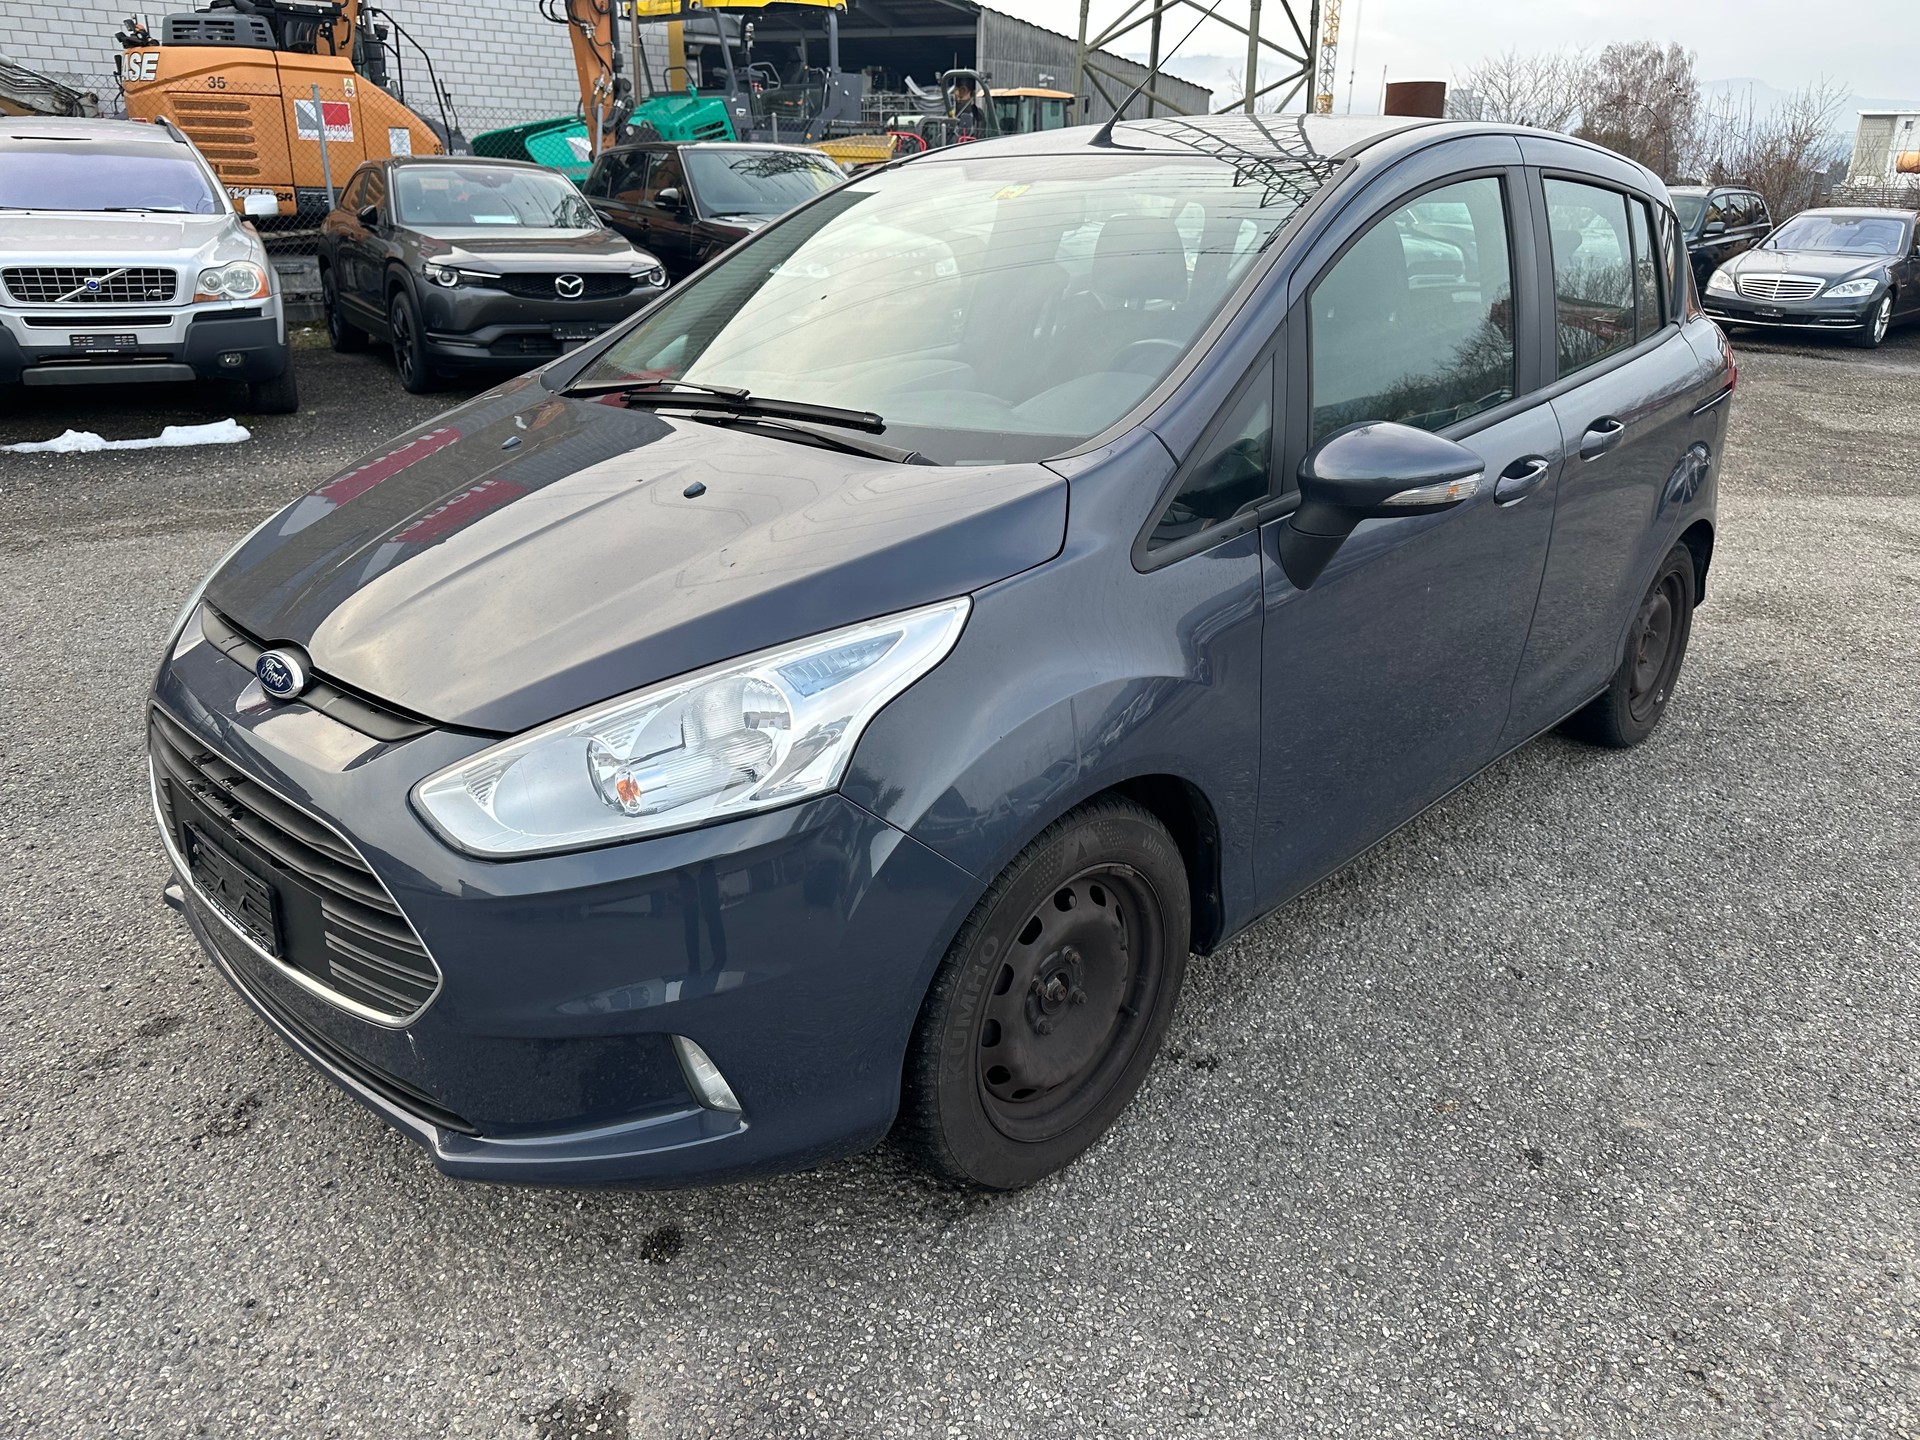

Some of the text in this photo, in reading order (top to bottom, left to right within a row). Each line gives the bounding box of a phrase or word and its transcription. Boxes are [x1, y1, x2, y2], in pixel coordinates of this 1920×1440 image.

[122, 51, 160, 81] ASE
[207, 76, 226, 89] 35
[433, 143, 444, 156] 35
[277, 192, 293, 202] SR
[260, 658, 287, 688] Ford
[945, 935, 1000, 1086] KUMHO
